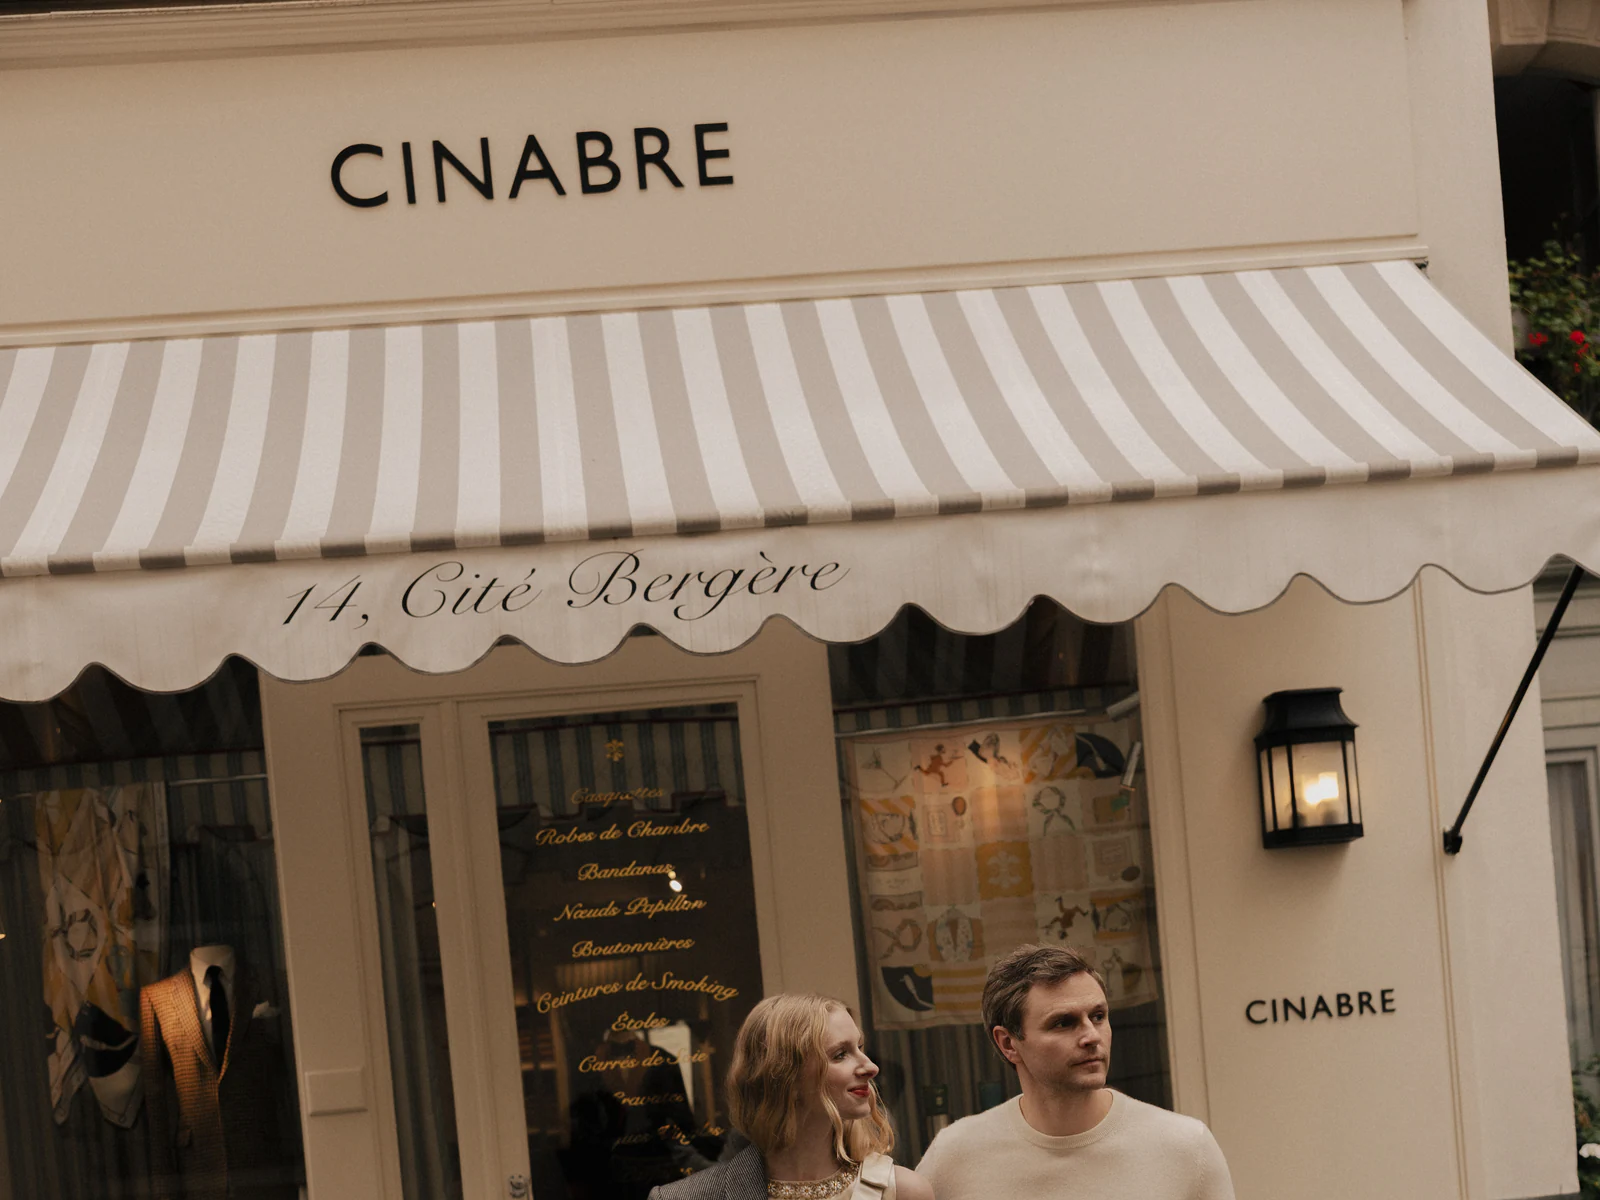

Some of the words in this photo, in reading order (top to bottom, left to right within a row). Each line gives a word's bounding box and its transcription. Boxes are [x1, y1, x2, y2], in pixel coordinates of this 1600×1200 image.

[330, 122, 734, 208] CINABRE
[282, 573, 370, 630] 14,
[399, 560, 543, 619] Cité
[567, 548, 852, 622] Bergère
[535, 826, 597, 846] Robes
[599, 823, 623, 841] de
[627, 817, 711, 838] Chambre
[577, 860, 676, 881] Bandanas
[553, 900, 622, 921] Nœuds
[624, 894, 707, 919] Papillon
[571, 937, 696, 958] Boutonnières
[536, 981, 625, 1014] Ceintures
[625, 972, 650, 992] de
[651, 971, 740, 1002] Smoking
[1245, 988, 1397, 1025] CINABRE
[611, 1010, 670, 1032] Étoles
[578, 1055, 639, 1074] Carrés
[641, 1049, 665, 1067] de
[666, 1047, 710, 1066] Sie
